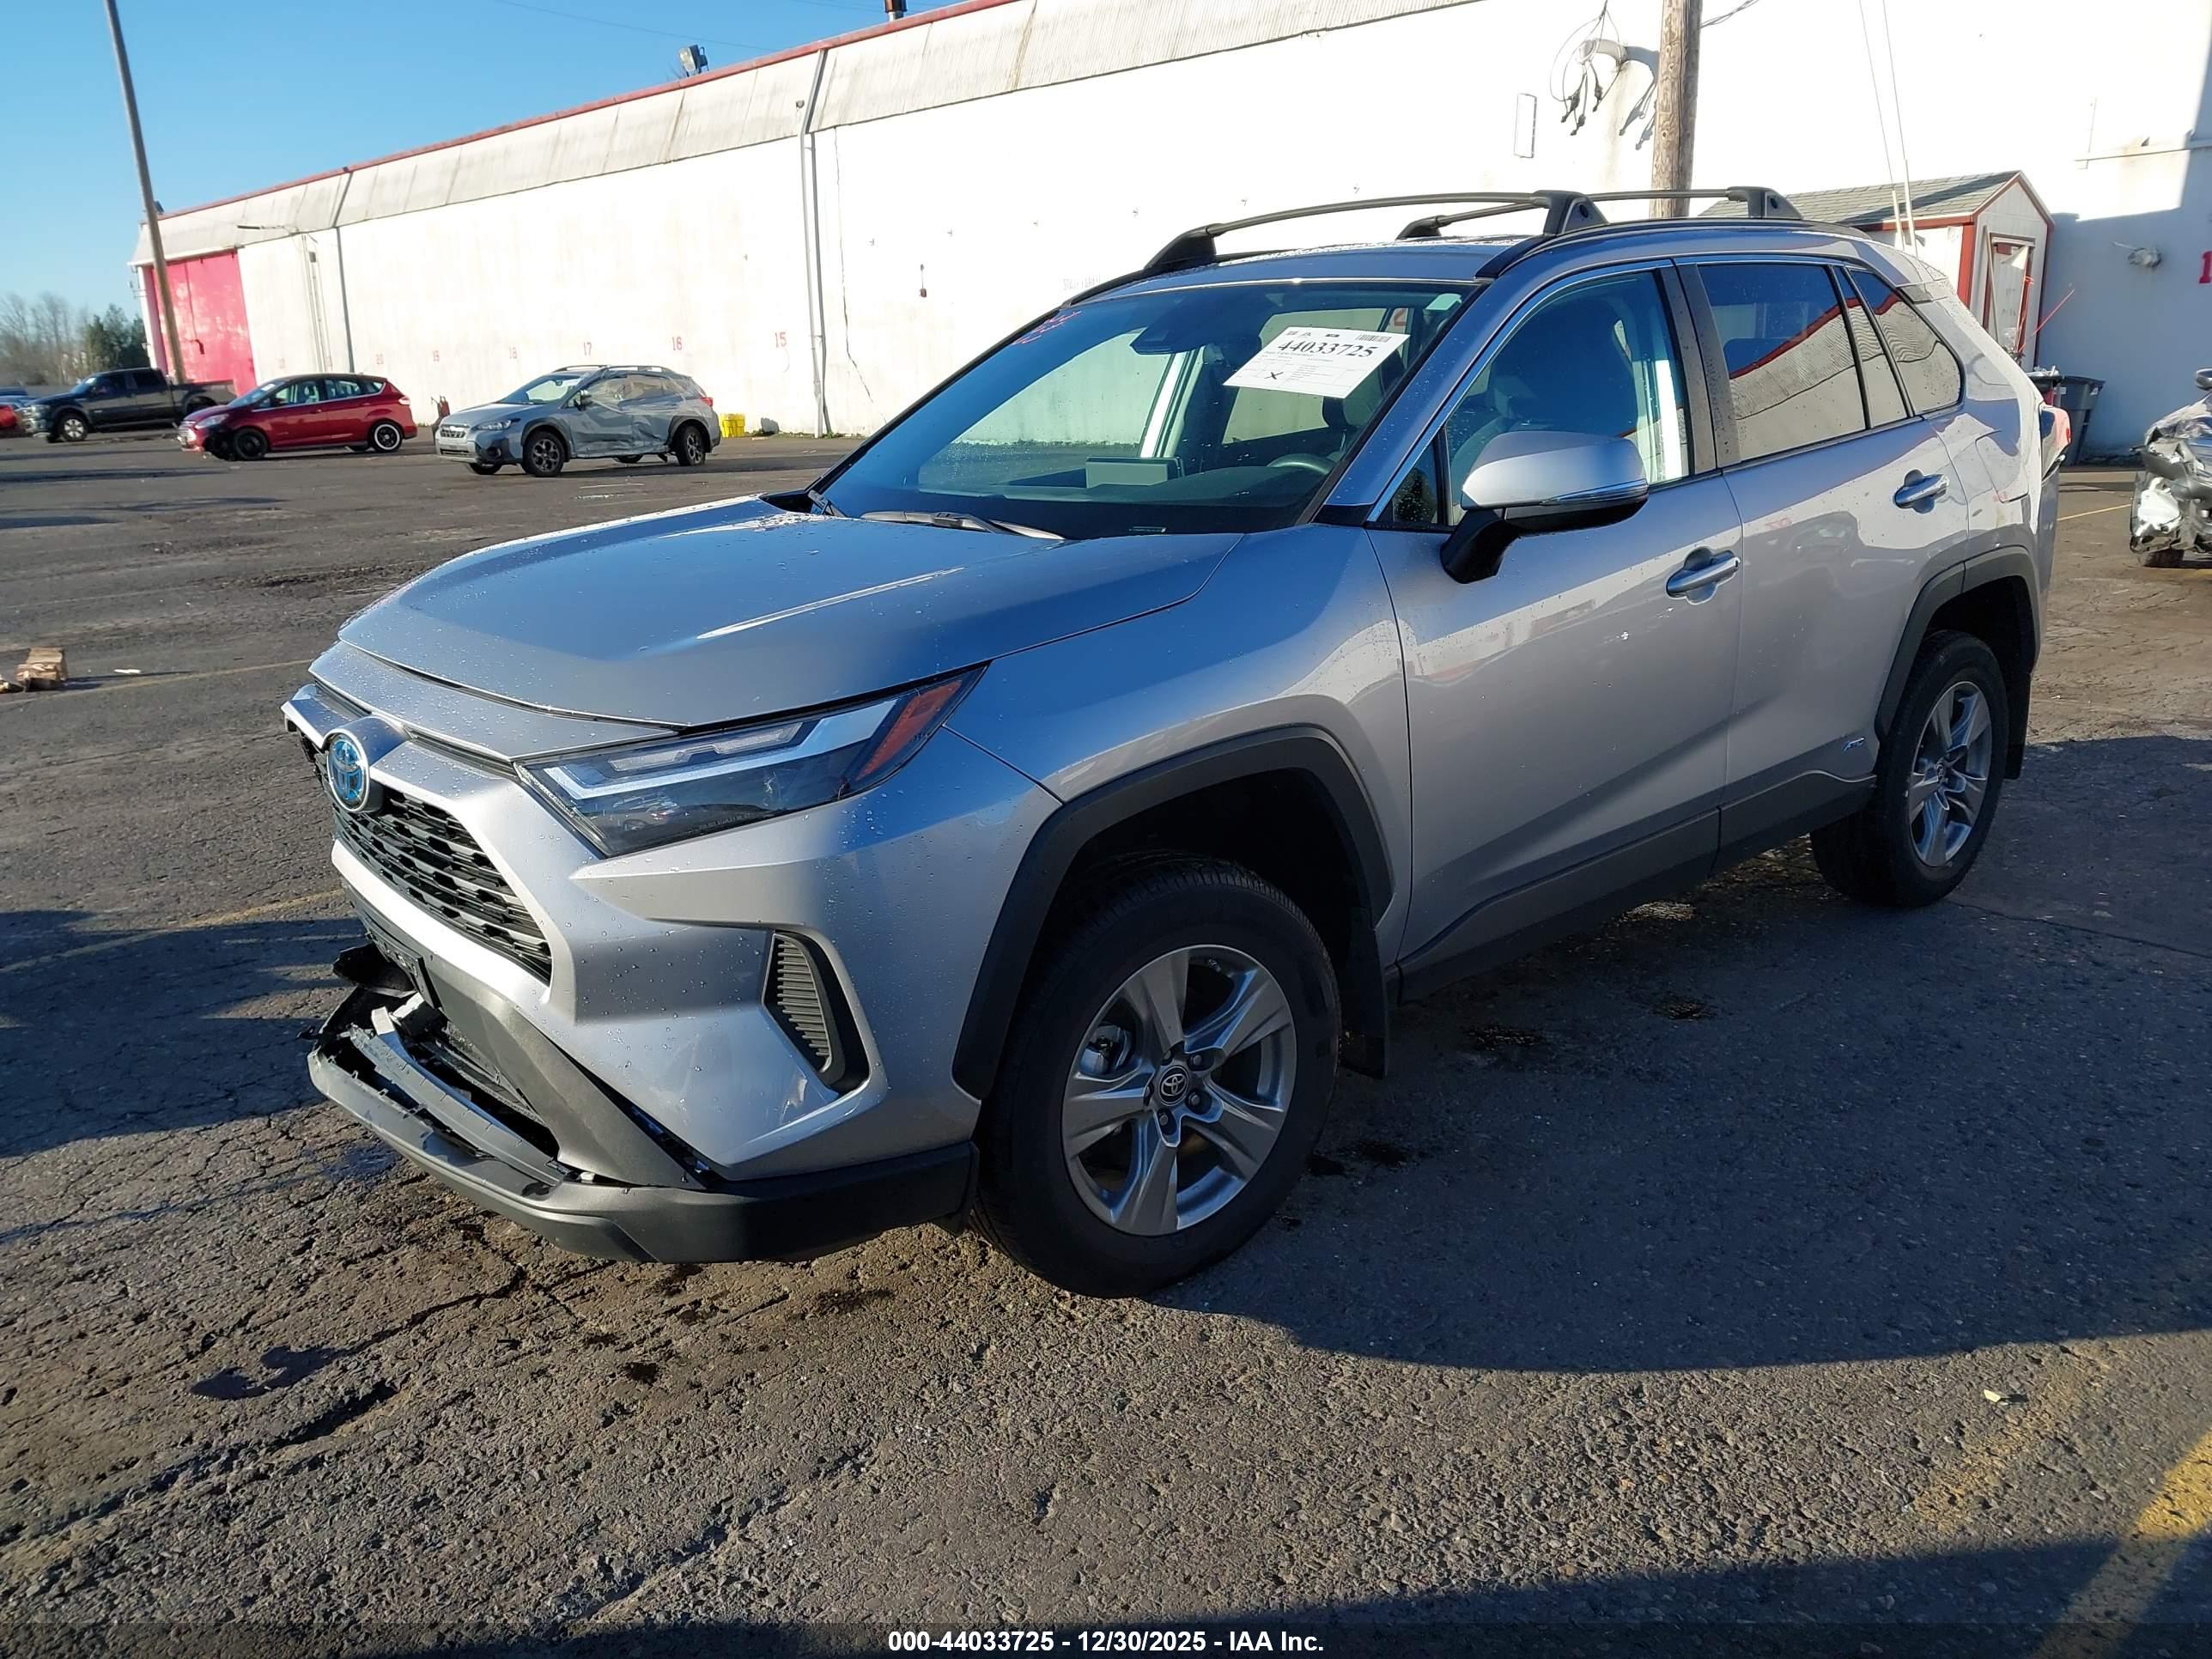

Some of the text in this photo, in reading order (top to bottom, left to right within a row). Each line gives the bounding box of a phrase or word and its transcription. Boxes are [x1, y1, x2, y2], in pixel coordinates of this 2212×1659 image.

[672, 336, 683, 351] 16
[775, 331, 787, 348] 15
[583, 342, 592, 356] 17
[1278, 339, 1380, 358] 44033725
